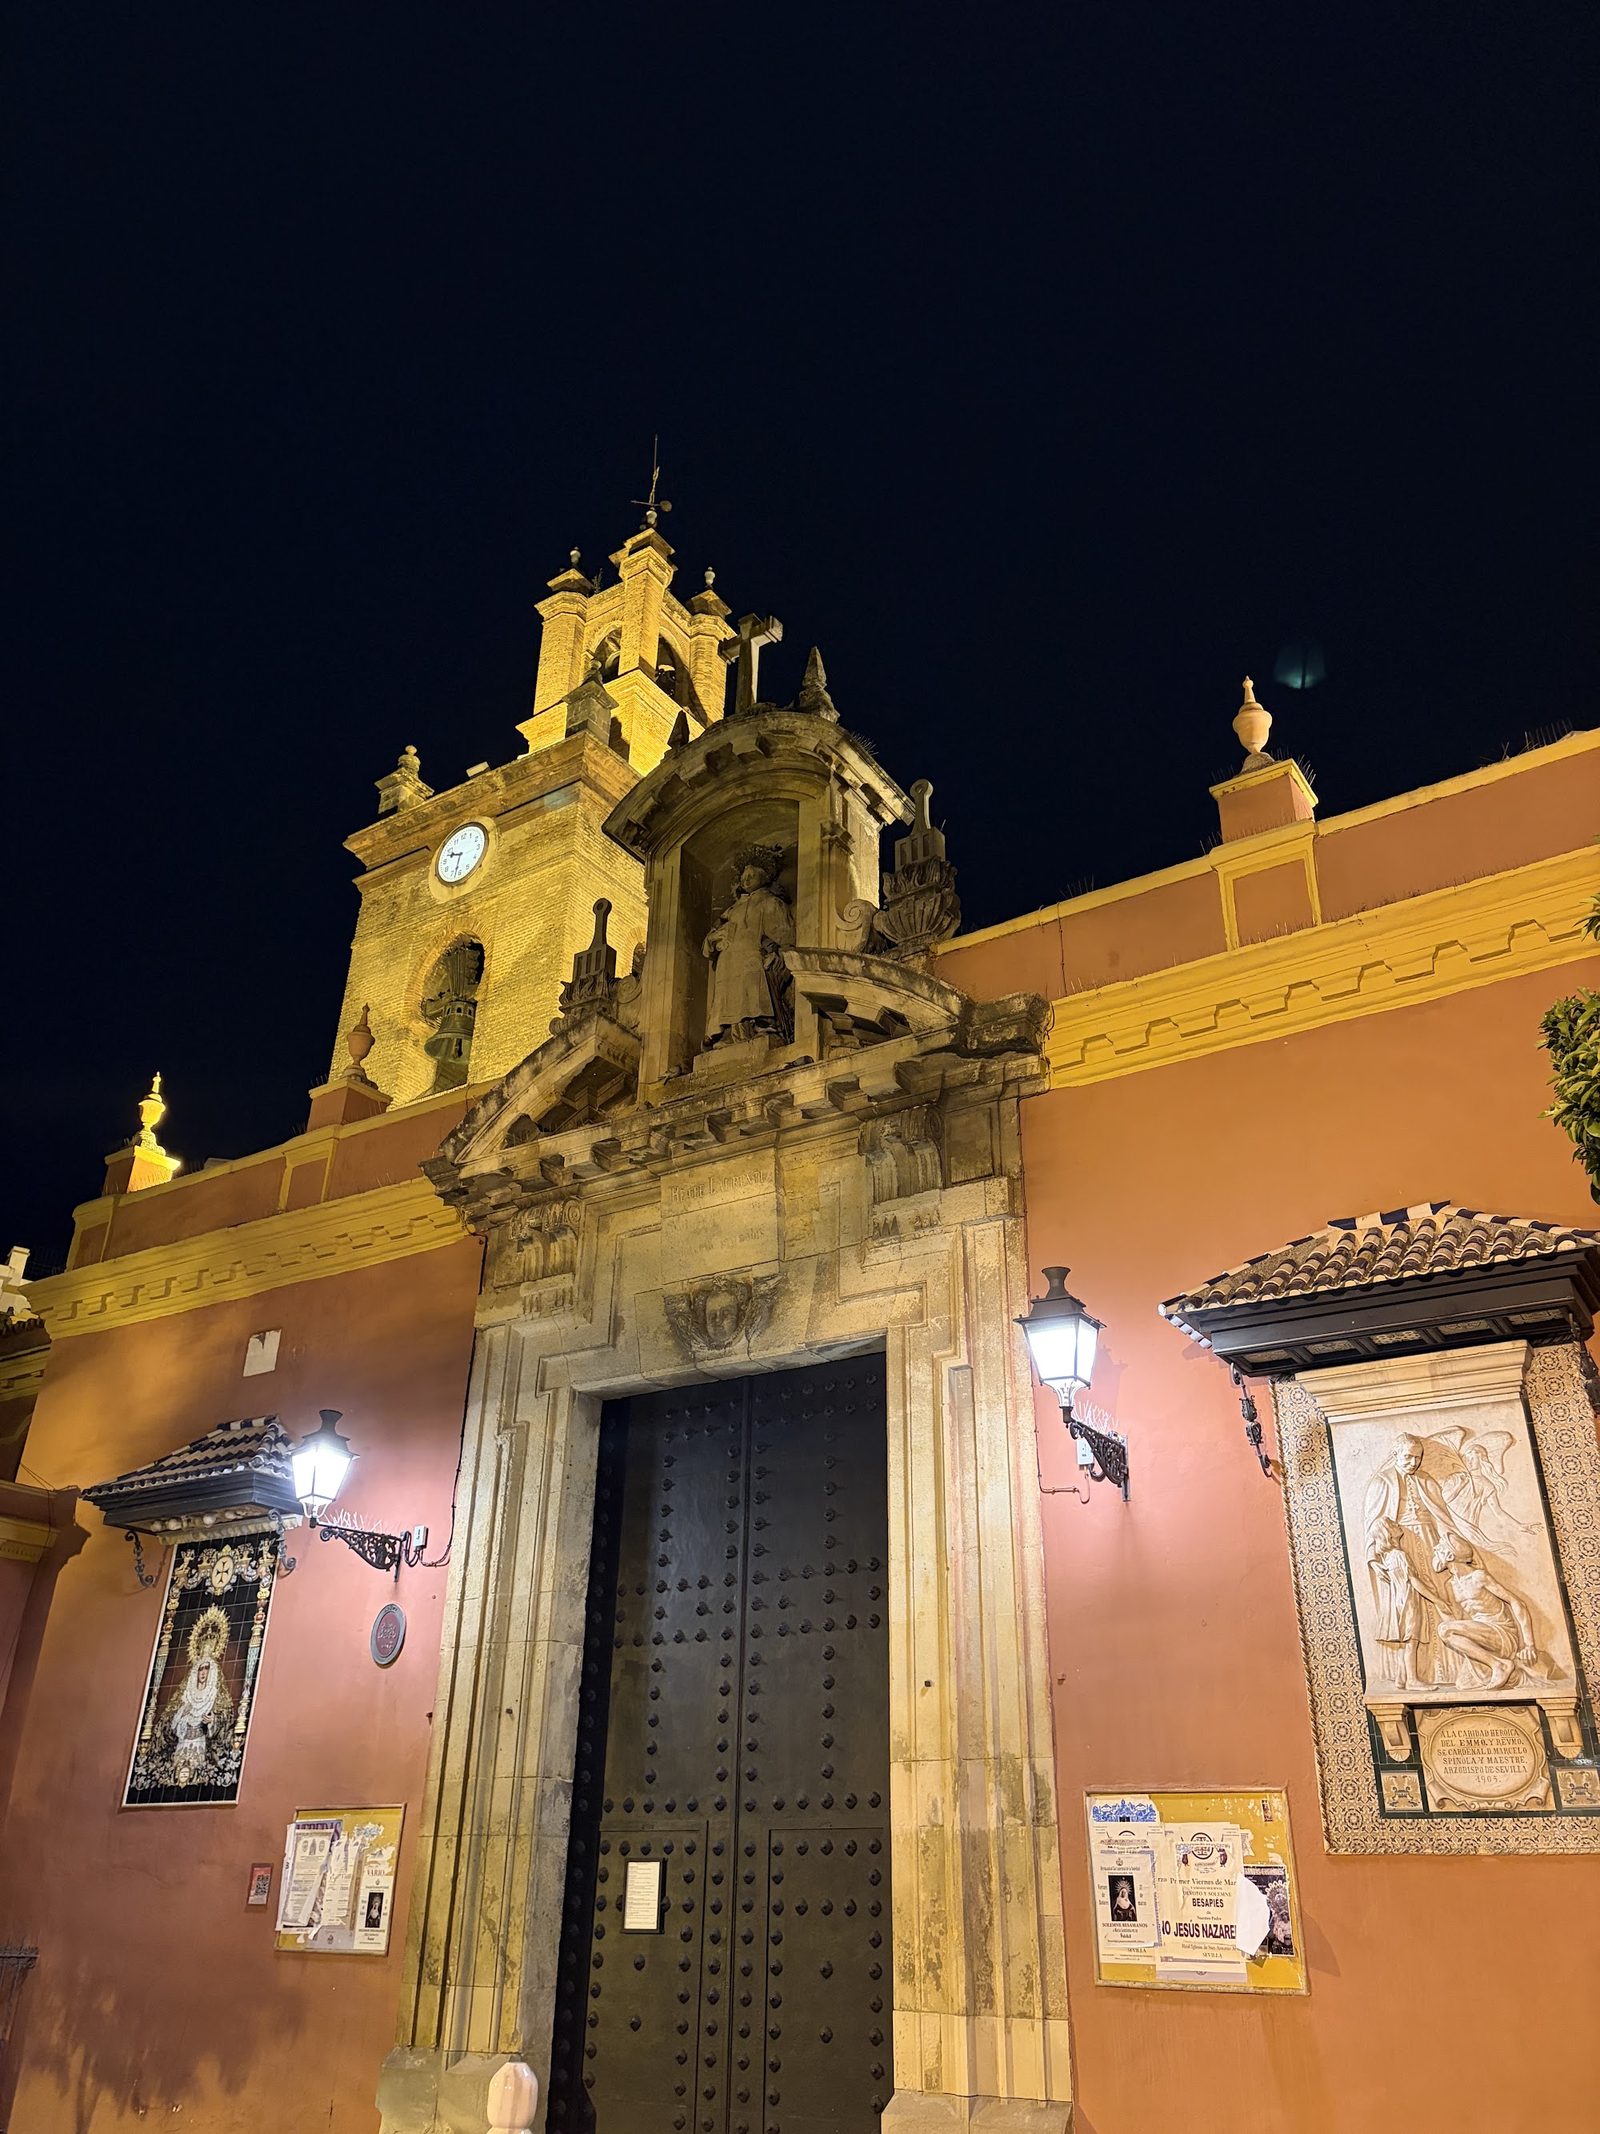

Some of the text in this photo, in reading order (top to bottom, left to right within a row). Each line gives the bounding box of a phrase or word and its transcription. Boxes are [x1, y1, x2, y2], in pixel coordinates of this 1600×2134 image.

[1446, 1730, 1457, 1738] LA
[1457, 1729, 1489, 1738] CARIDAD
[1441, 1739, 1455, 1747] DEL
[1448, 1748, 1486, 1756] CARDENAL
[1493, 1747, 1528, 1755] MARCELO
[1443, 1765, 1528, 1774] ARZOBISPO DE SEVILLA
[1170, 1877, 1190, 1885] Prmer
[1192, 1896, 1224, 1908] BESAPIÉS
[1173, 1919, 1200, 1938] JESÚS
